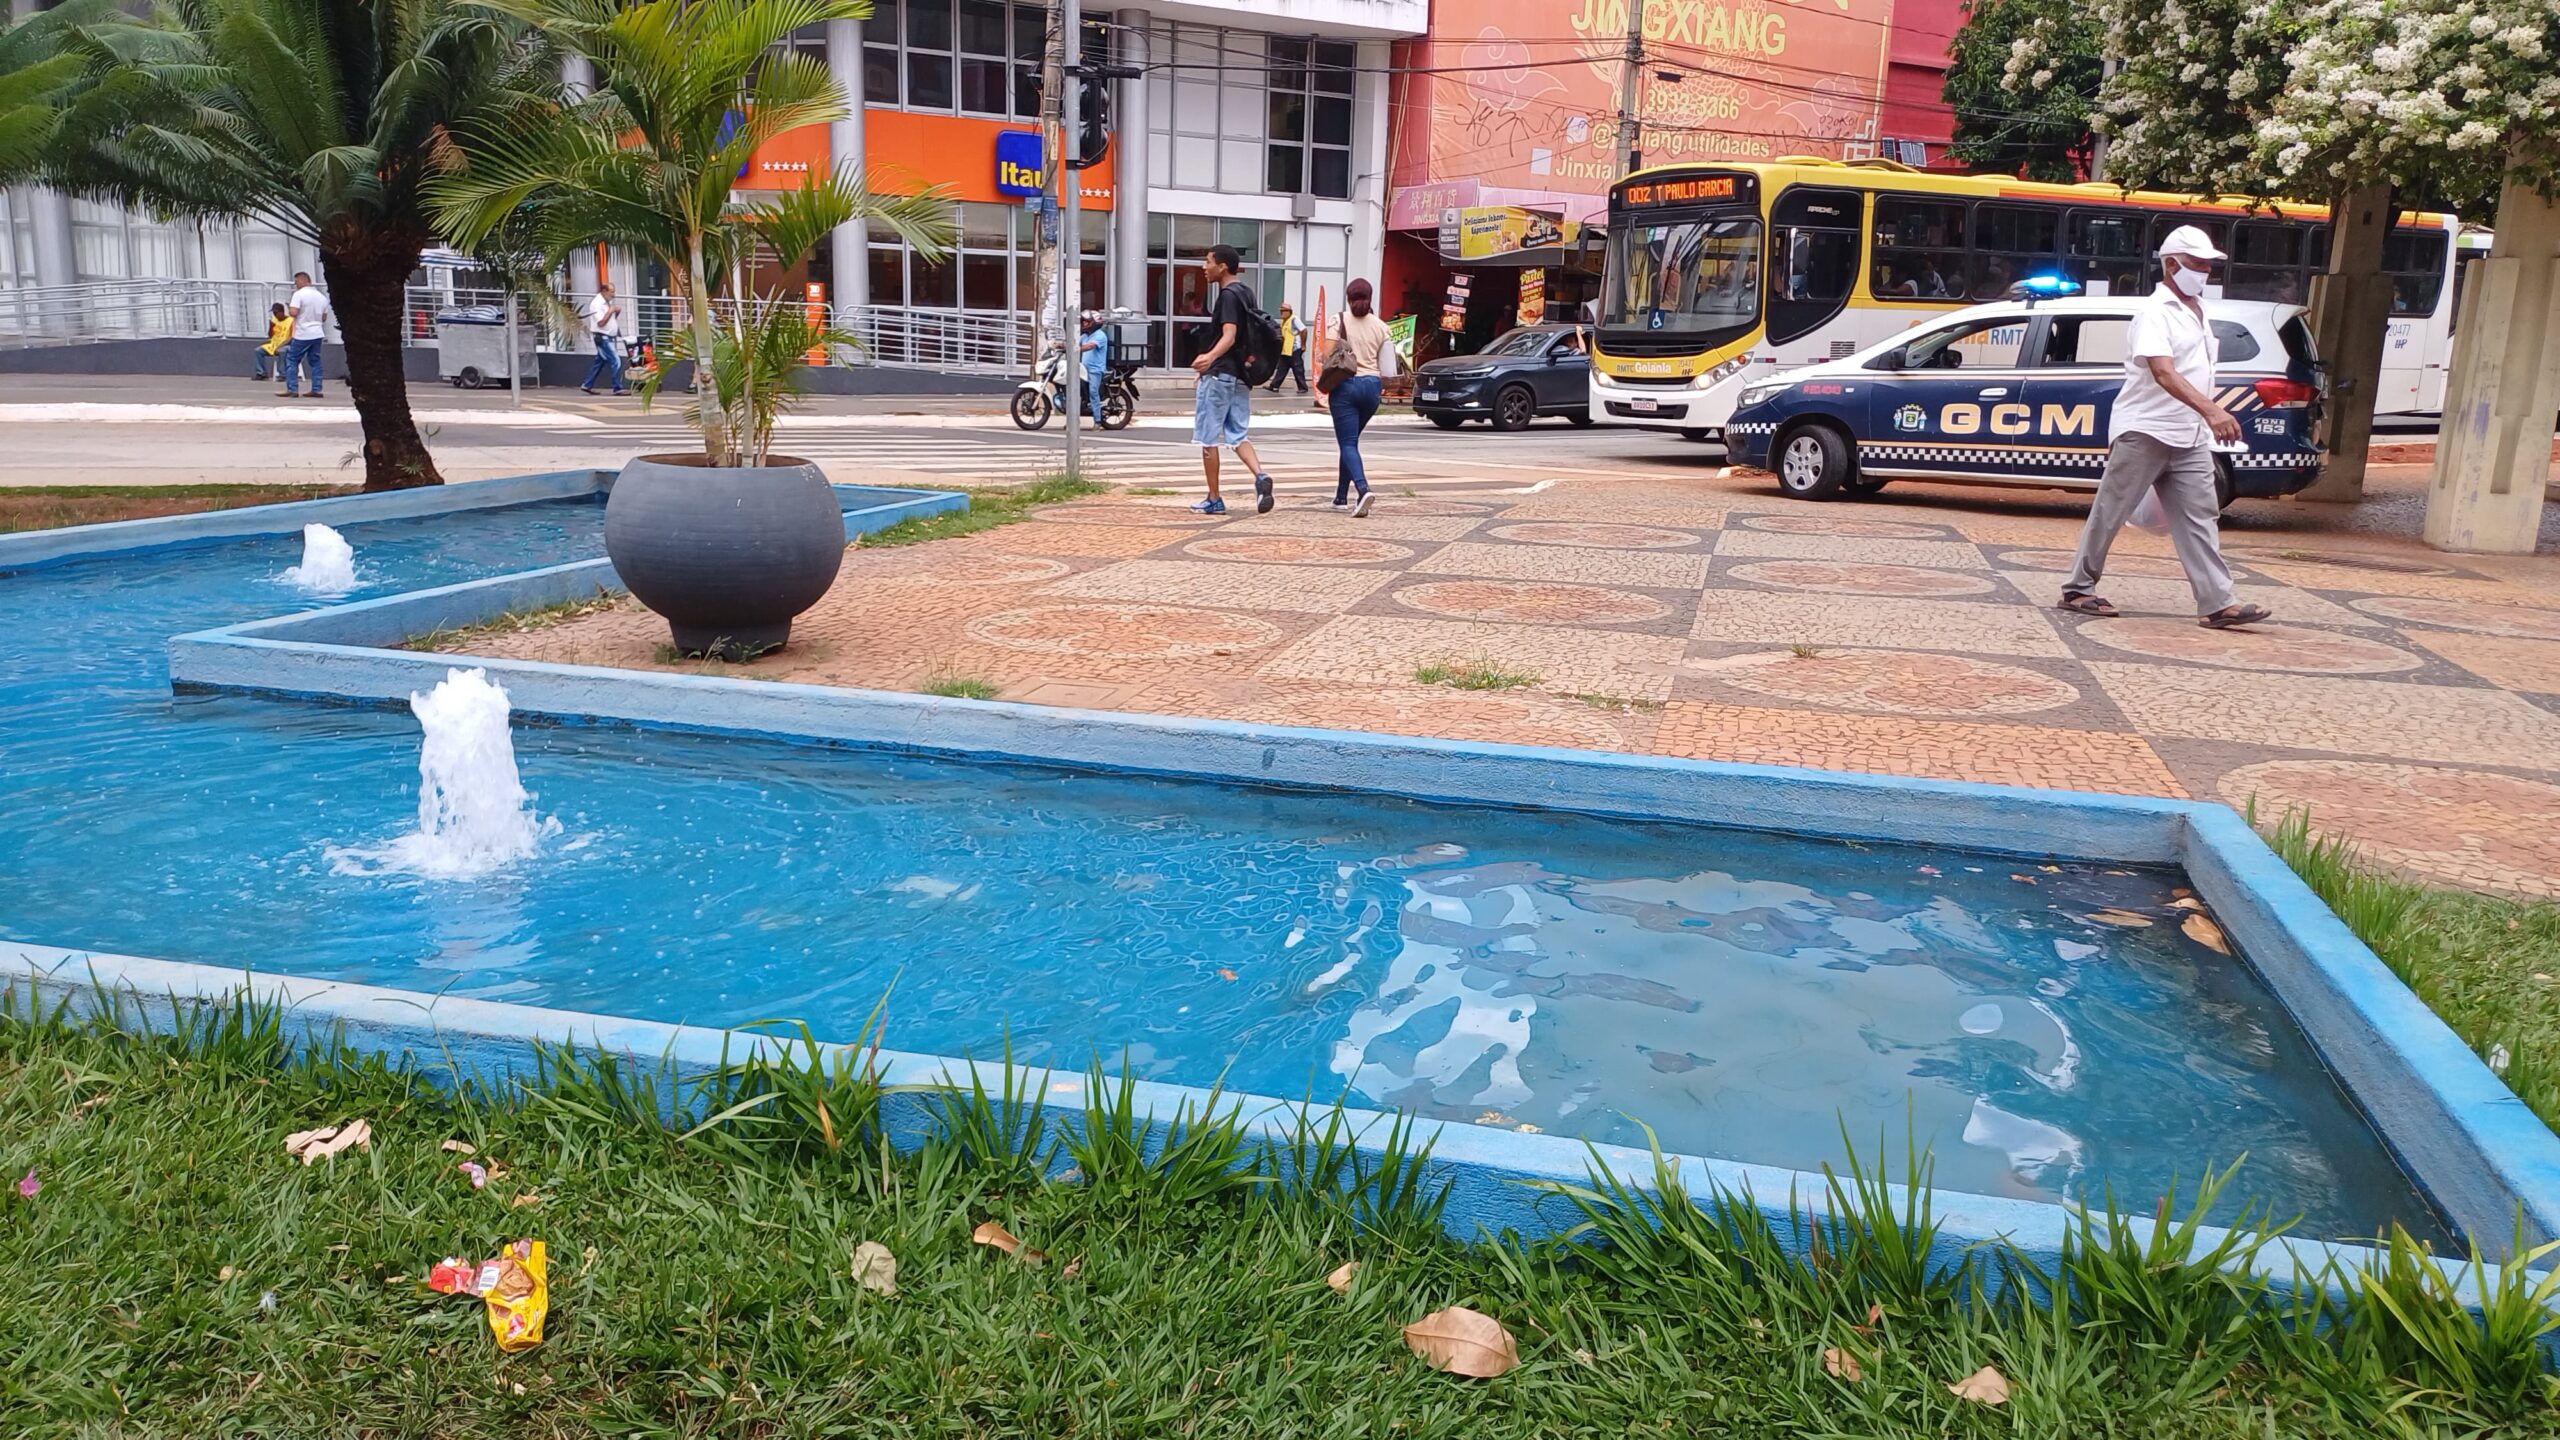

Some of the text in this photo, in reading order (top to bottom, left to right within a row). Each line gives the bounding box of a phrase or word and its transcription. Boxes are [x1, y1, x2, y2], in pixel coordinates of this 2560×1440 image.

[1571, 0, 1786, 55] JINGXIANG
[1628, 179, 1733, 203] 002 T PAULO GARCIA
[1412, 213, 1440, 226] JINGXIA
[1991, 328, 2024, 346] RMT
[1616, 364, 1635, 374] RMTC
[1940, 403, 2096, 436] GCM
[2254, 424, 2285, 434] 153
